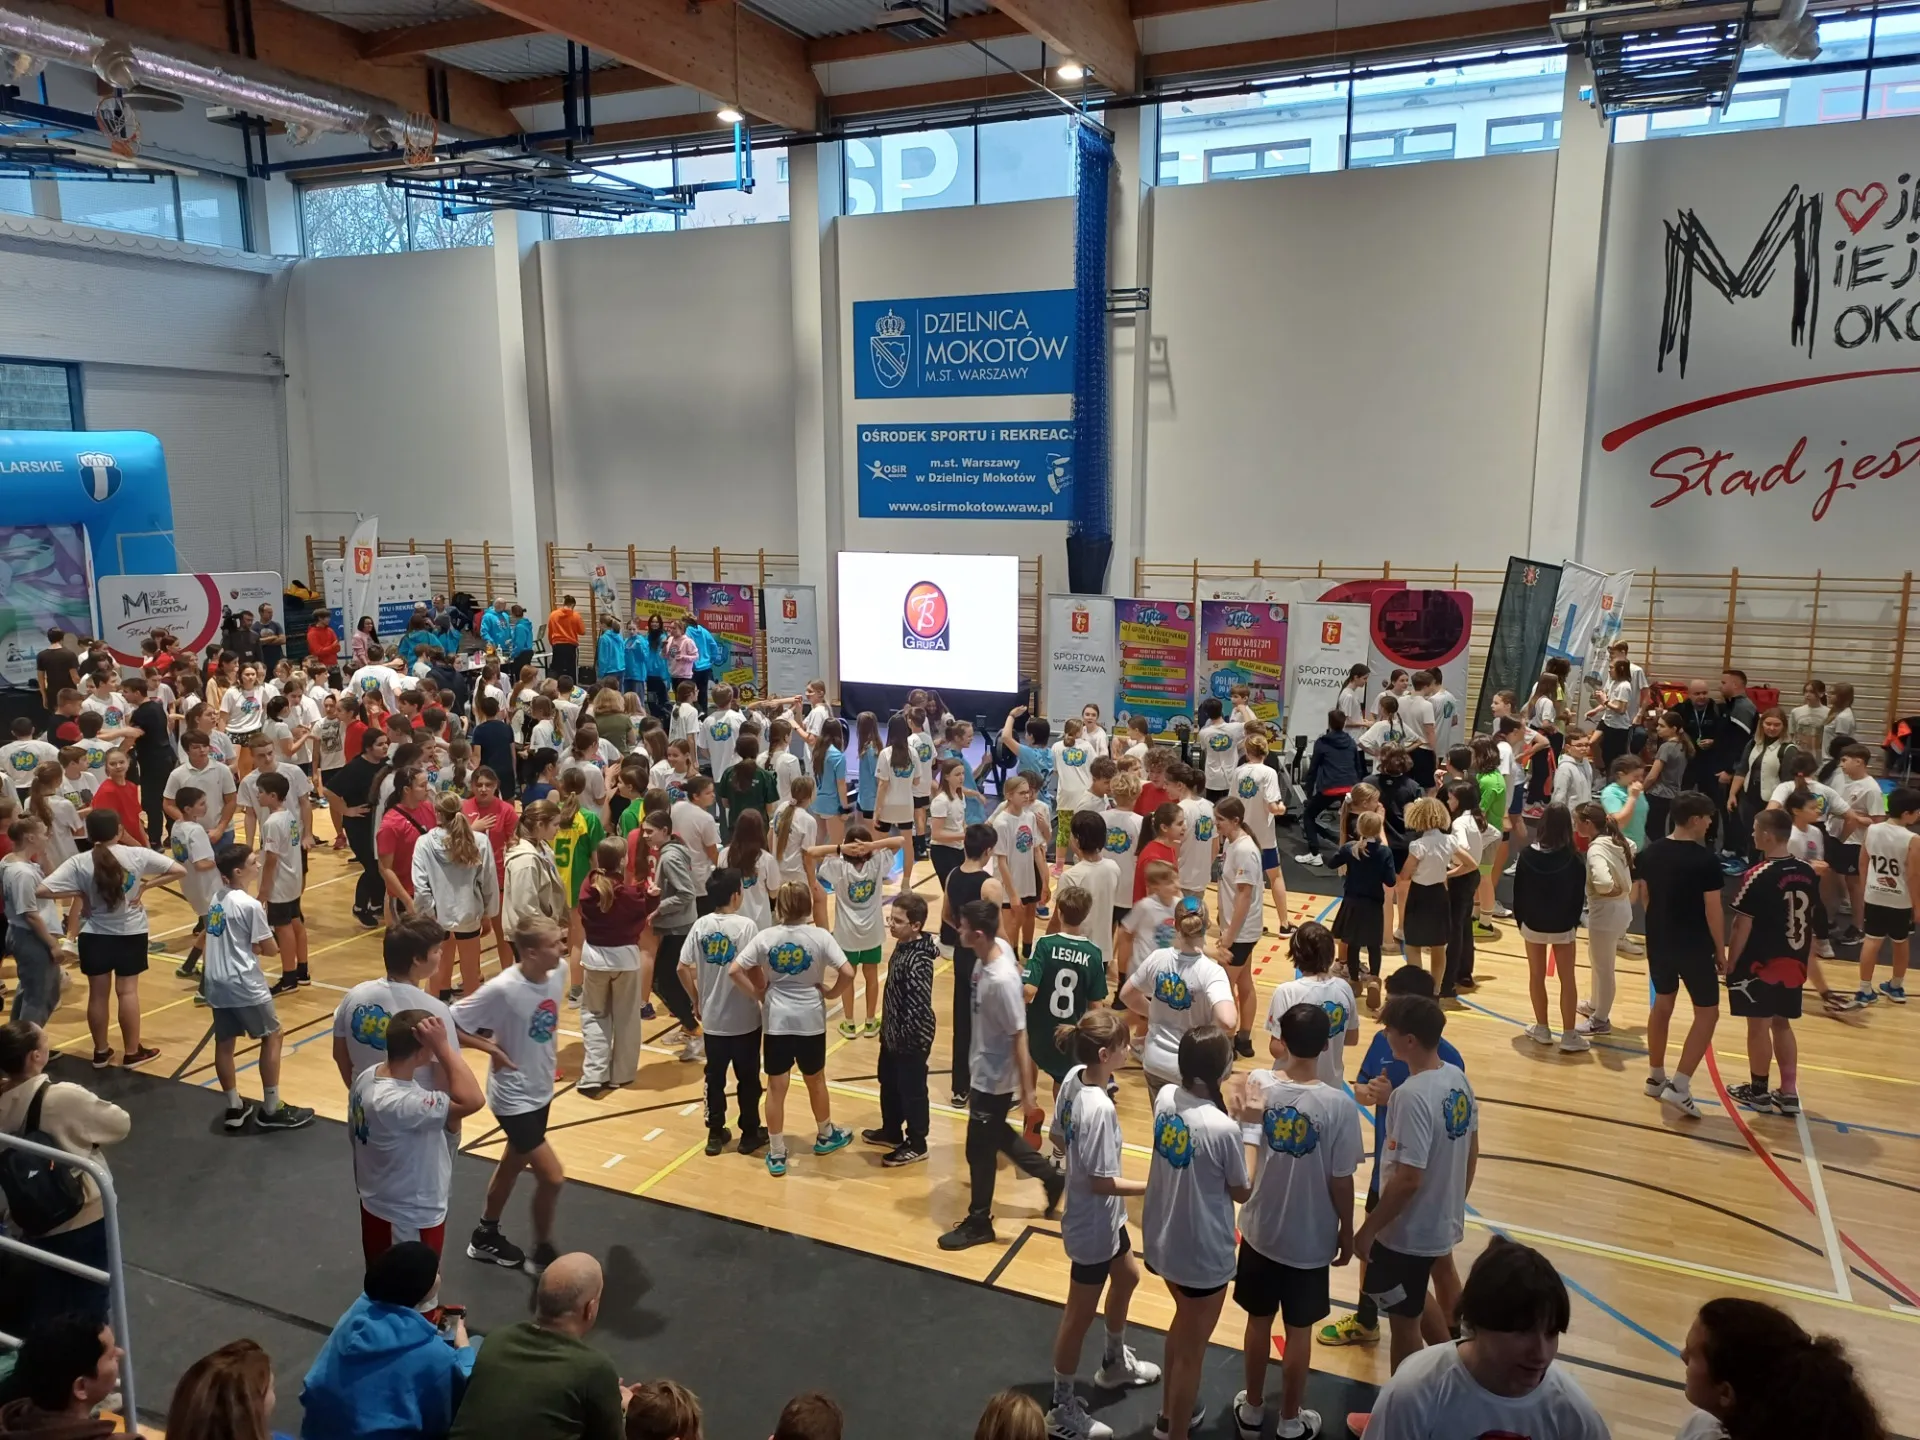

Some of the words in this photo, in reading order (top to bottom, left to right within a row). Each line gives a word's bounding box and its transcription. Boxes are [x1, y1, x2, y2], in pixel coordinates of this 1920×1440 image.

[925, 309, 1030, 333] DZIELNICA
[925, 331, 1069, 364] MOKOTÓW
[925, 369, 955, 382] M.ST.
[958, 367, 1029, 381] WARSZAWY
[862, 429, 927, 442] OŚRODEK
[931, 430, 987, 442] SPORTU
[991, 429, 996, 441] i
[930, 458, 958, 468] m.st.
[962, 457, 1020, 470] Warszawy
[916, 474, 925, 483] w
[928, 473, 979, 485] Dzielnicy
[983, 473, 1036, 483] Mokotów
[888, 502, 1054, 515] www.osirmokotow.waw.pl
[770, 636, 812, 646] SPORTOWA
[770, 646, 813, 656] WARSZAWA
[1053, 652, 1105, 662] SPORTOWA
[1053, 663, 1106, 673] WARSZAWA
[1298, 665, 1350, 677] SPORTOW
[1297, 678, 1345, 688] WARSZA
[555, 838, 572, 868] 5
[1871, 855, 1900, 877] 126
[777, 948, 804, 966] #9
[1051, 946, 1091, 967] LESIAK
[1049, 968, 1079, 1019] 8
[1273, 1118, 1307, 1143] #9
[1161, 1123, 1188, 1155] #9
